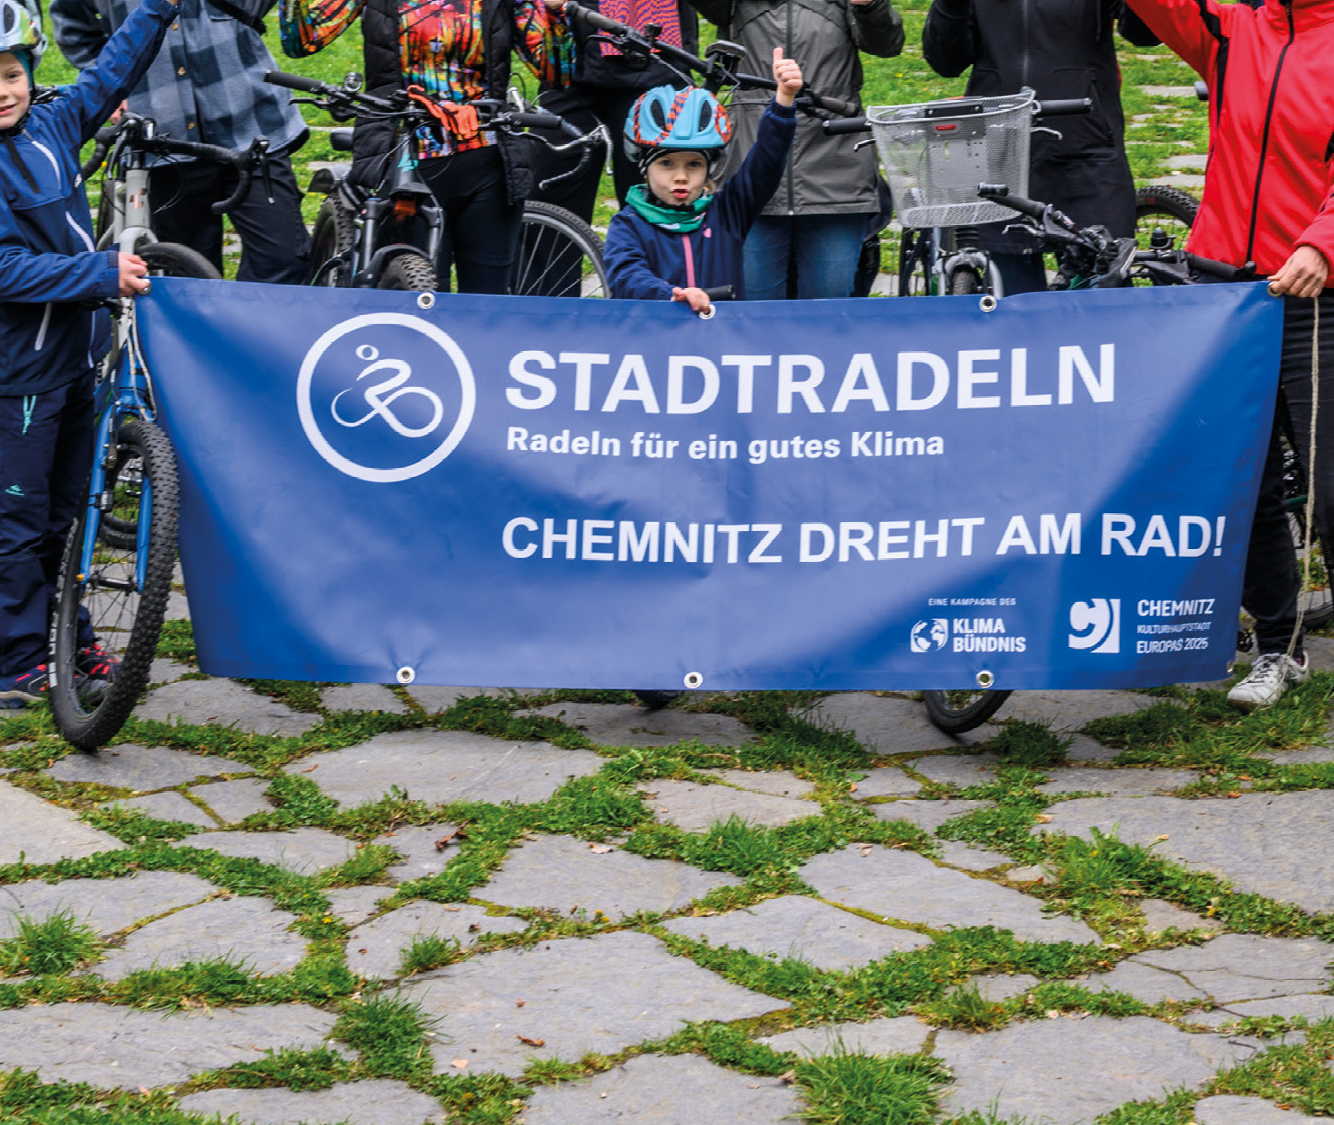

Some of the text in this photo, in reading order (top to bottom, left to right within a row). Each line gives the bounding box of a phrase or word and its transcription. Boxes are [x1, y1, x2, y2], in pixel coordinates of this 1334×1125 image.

[505, 343, 1115, 415] STADTRADELN
[507, 426, 945, 465] Radeln für ein gutes Klima
[501, 512, 1227, 564] CHEMNITZ DREHT AM RAD!
[928, 597, 1017, 606] EINE KAMPAGNE DES
[1137, 598, 1216, 617] CHEMNITZ
[953, 618, 1006, 634] KLIMA
[953, 634, 1026, 653] BÜNDNIS
[1183, 637, 1210, 651] 2025
